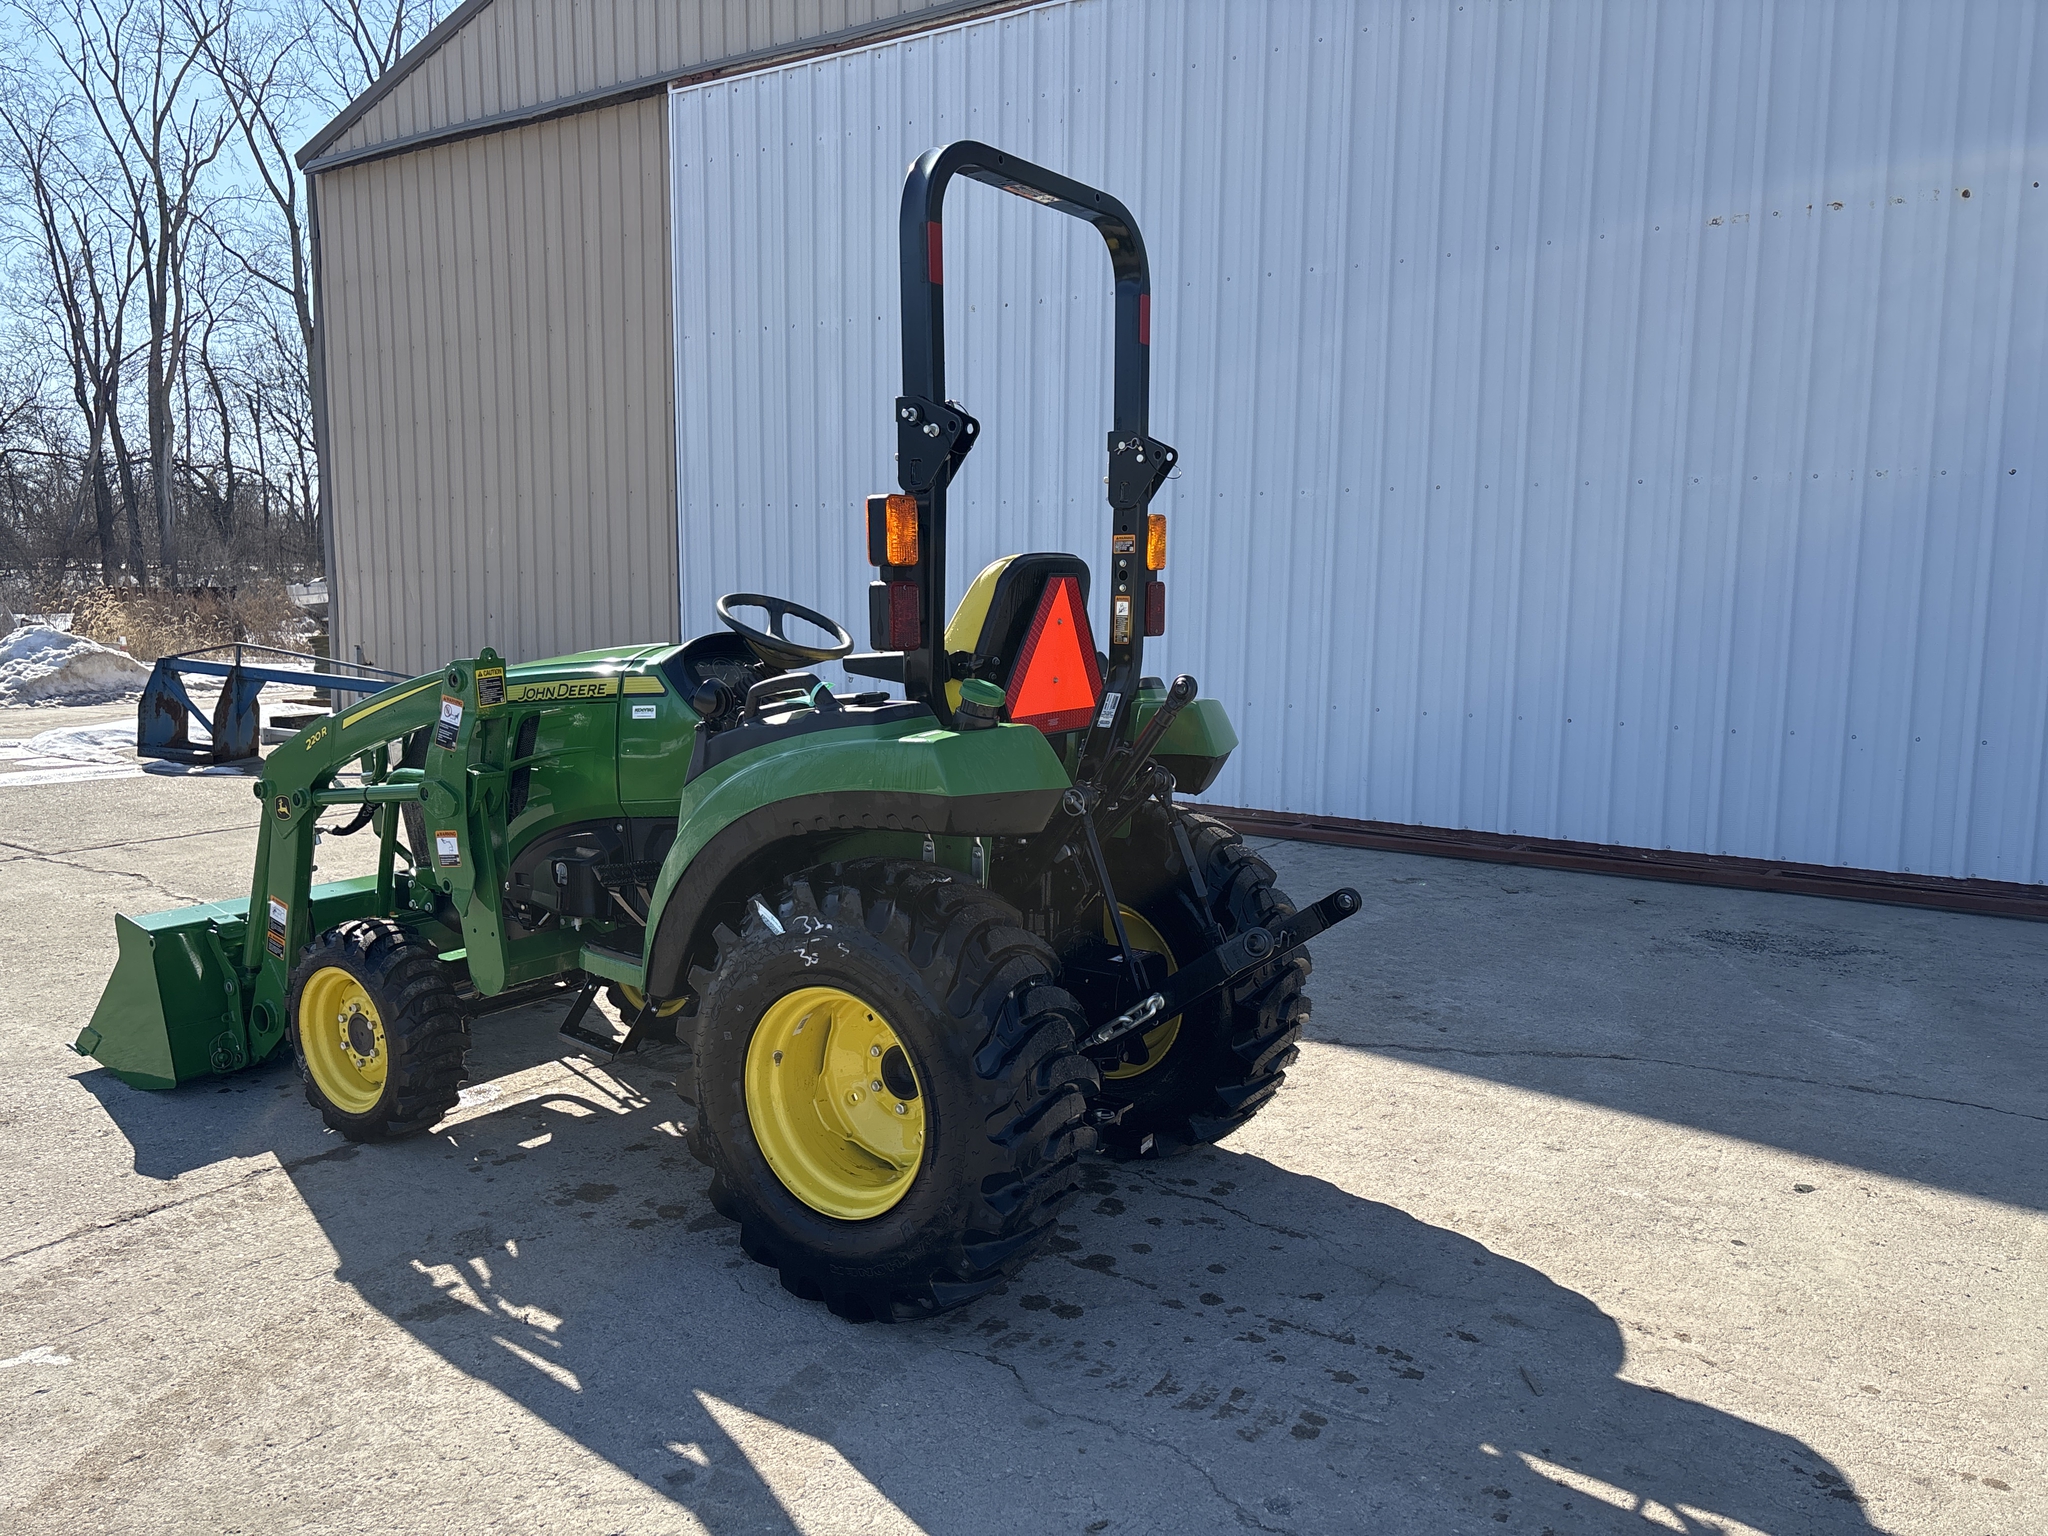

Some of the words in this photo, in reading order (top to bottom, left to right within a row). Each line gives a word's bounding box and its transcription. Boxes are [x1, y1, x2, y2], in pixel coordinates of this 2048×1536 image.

[484, 668, 502, 676] CAUTION
[517, 686, 555, 700] JOHN
[557, 683, 607, 698] DEERE
[710, 937, 790, 1022] GALAXY
